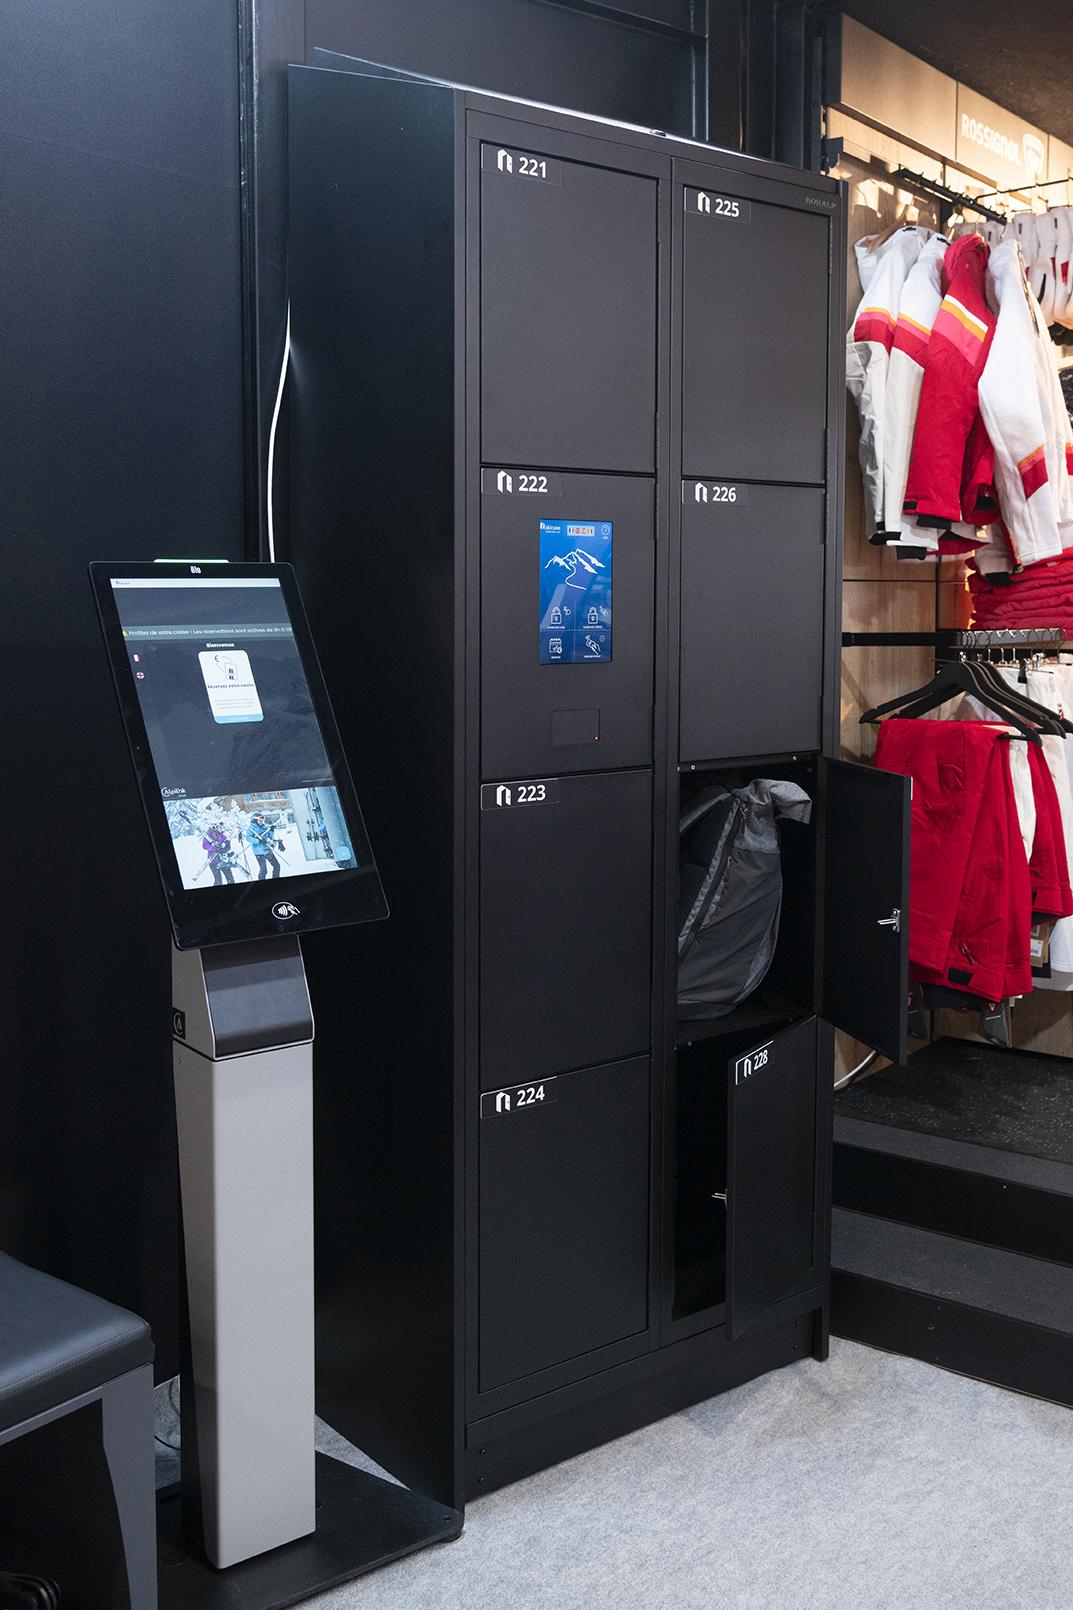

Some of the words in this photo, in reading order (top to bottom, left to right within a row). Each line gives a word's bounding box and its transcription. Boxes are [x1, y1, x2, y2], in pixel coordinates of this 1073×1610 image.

[961, 113, 1021, 166] ROSSIGNOL
[518, 156, 546, 178] 221
[715, 198, 740, 217] 225
[518, 475, 548, 493] 222
[712, 486, 737, 502] 226
[517, 784, 546, 802] 223
[753, 1049, 768, 1070] 228
[517, 1085, 545, 1106] 224
